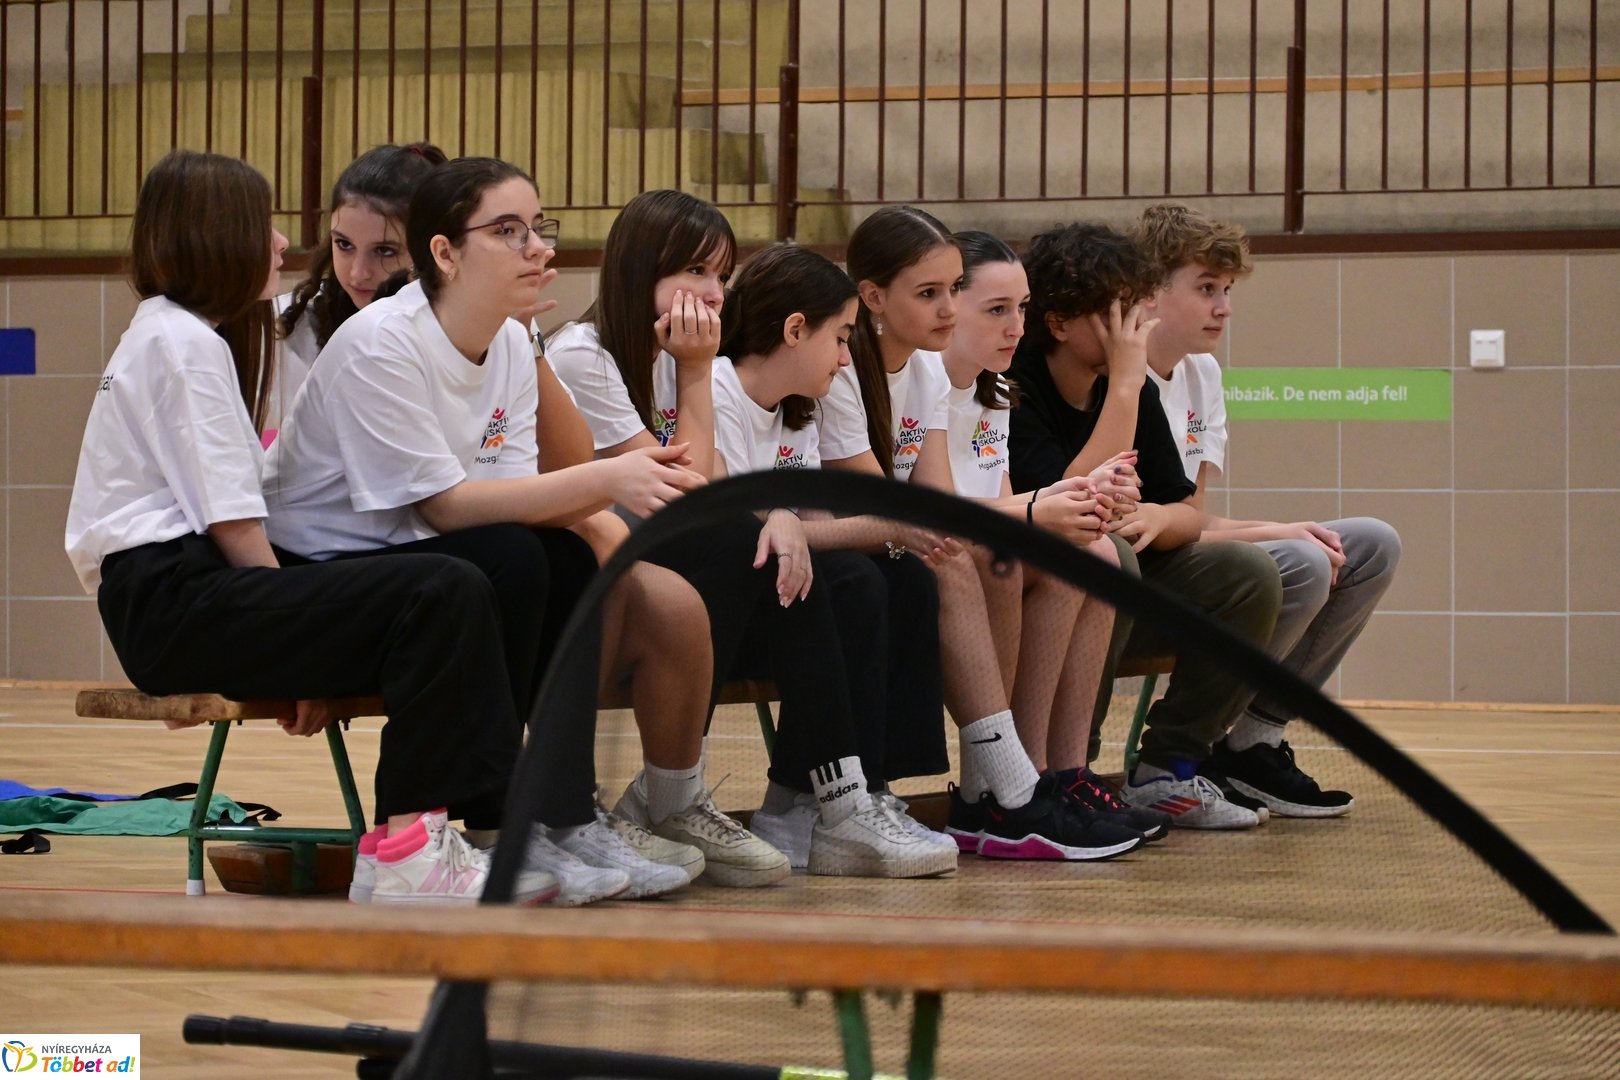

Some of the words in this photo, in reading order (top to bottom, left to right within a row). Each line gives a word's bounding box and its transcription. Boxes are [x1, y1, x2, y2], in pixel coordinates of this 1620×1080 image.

[1283, 386, 1305, 401] De
[1309, 388, 1342, 401] nem
[1346, 385, 1379, 405] adja
[1382, 384, 1408, 401] fel!
[819, 782, 859, 804] adidas
